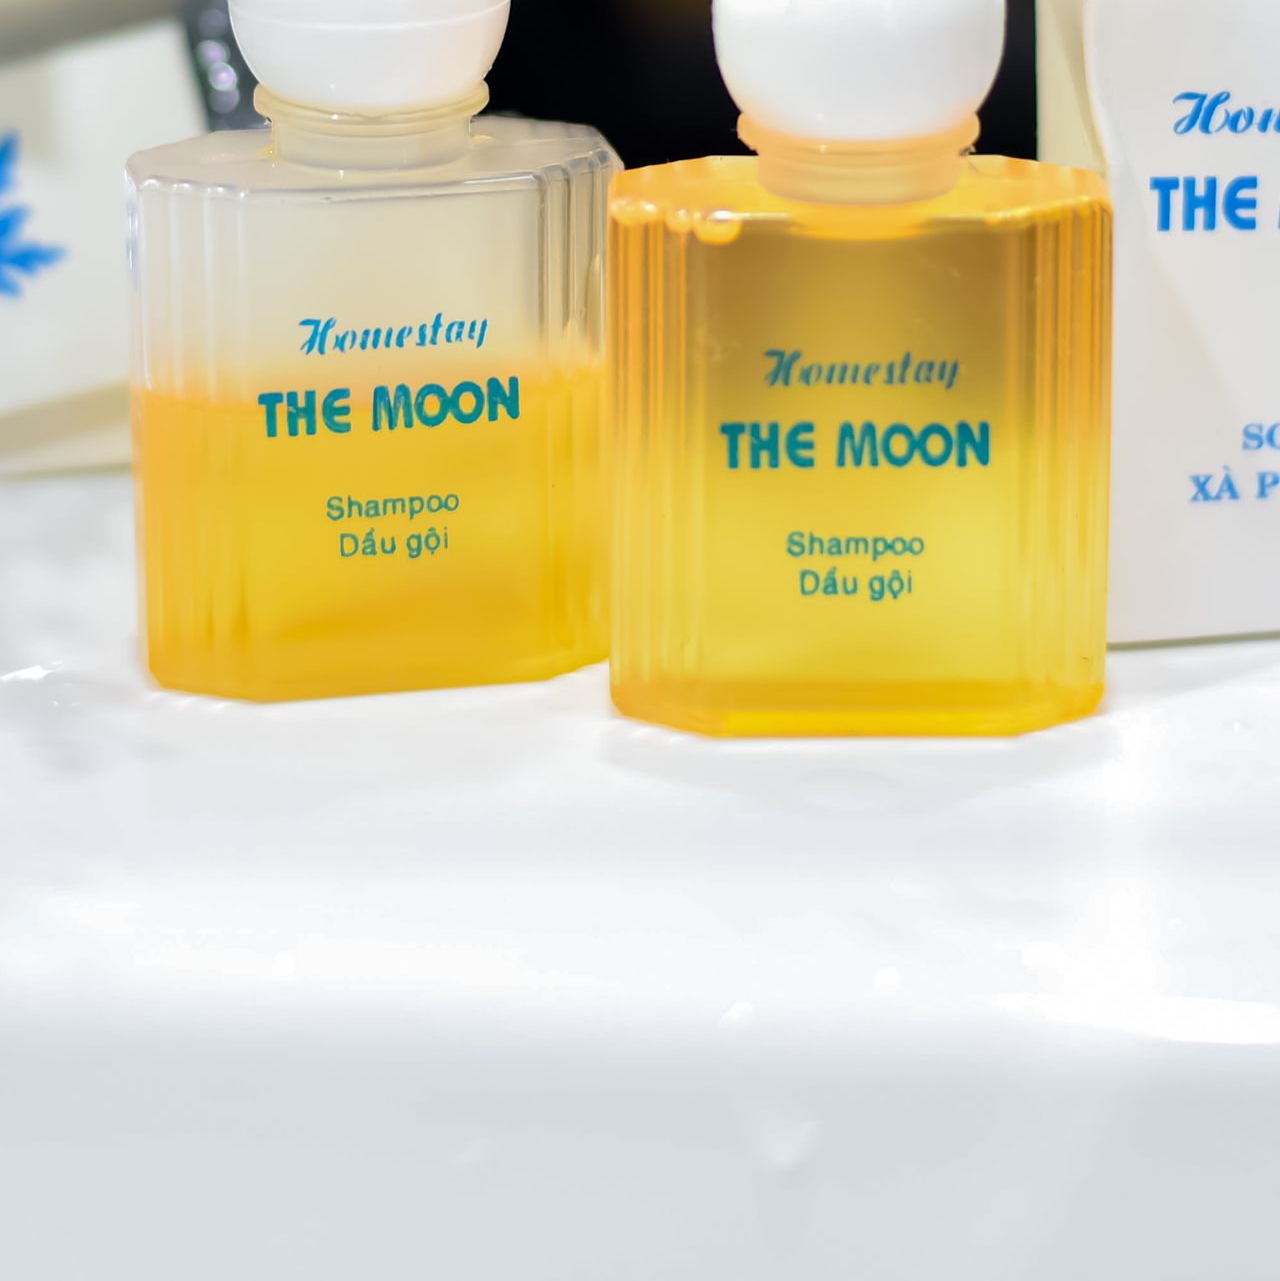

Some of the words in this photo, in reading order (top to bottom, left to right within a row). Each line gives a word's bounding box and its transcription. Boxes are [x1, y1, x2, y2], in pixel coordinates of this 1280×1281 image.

[1148, 174, 1260, 233] THE
[297, 311, 489, 356] Homestay
[762, 347, 961, 391] Homestay
[256, 386, 353, 439] THE
[370, 375, 521, 433] MOON
[718, 420, 816, 471] THE
[835, 419, 992, 469] MOON
[1189, 464, 1241, 504] XÀ
[325, 493, 461, 523] Shampoo
[784, 530, 926, 563] Shampoo
